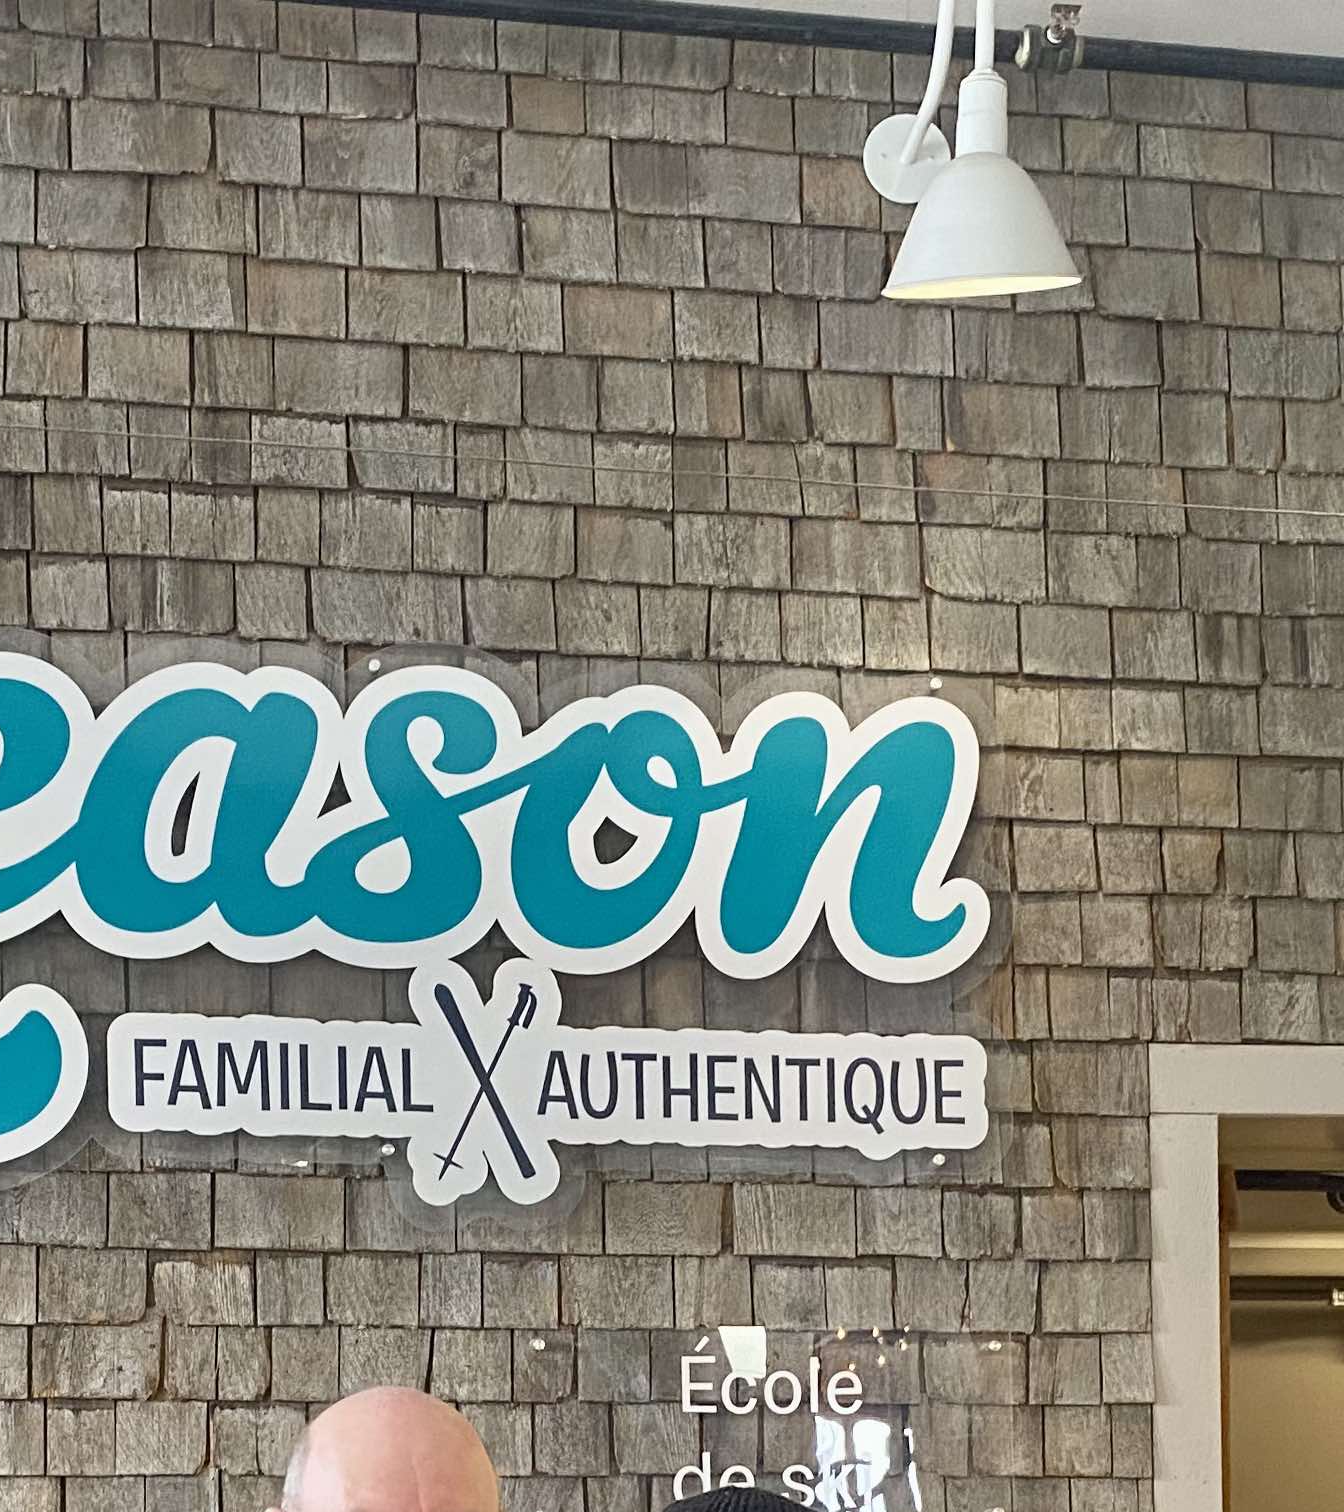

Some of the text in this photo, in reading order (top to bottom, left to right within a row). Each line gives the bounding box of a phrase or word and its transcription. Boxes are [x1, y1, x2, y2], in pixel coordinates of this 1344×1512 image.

[134, 1038, 966, 1135] FAMILIAL AUTHENTIQUE
[680, 1336, 863, 1415] École
